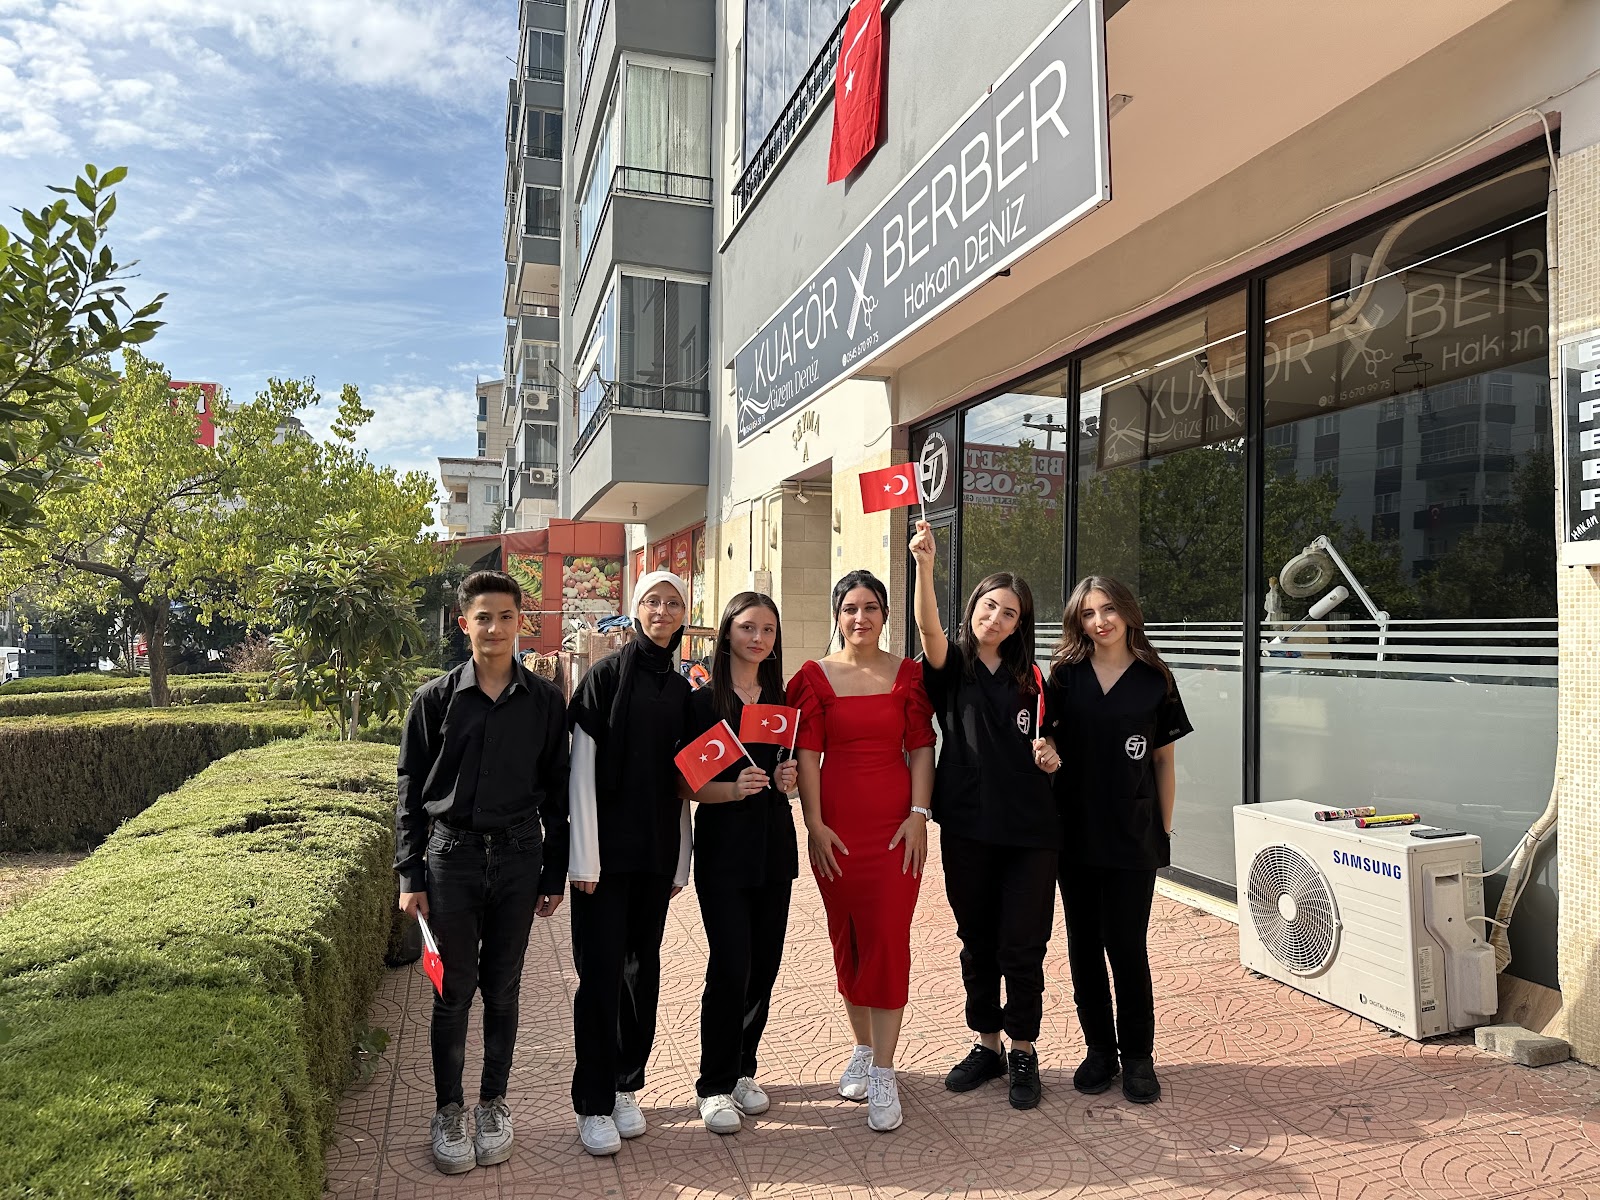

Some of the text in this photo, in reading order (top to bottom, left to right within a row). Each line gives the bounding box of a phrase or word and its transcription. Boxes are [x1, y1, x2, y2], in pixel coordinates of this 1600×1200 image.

[755, 60, 1070, 393] KUAFÖR BERBER
[904, 194, 1027, 318] Hakan DENİZ
[770, 356, 820, 411] Gizem Deniz
[1348, 385, 1365, 399] 670
[1366, 382, 1378, 394] 99
[1380, 379, 1391, 391] 75
[802, 441, 809, 463] A
[1570, 514, 1599, 541] HAKAN
[1333, 849, 1402, 880] SAMSUNG
[1369, 999, 1386, 1011] DIGITAL
[1385, 1006, 1406, 1019] INVERTER
